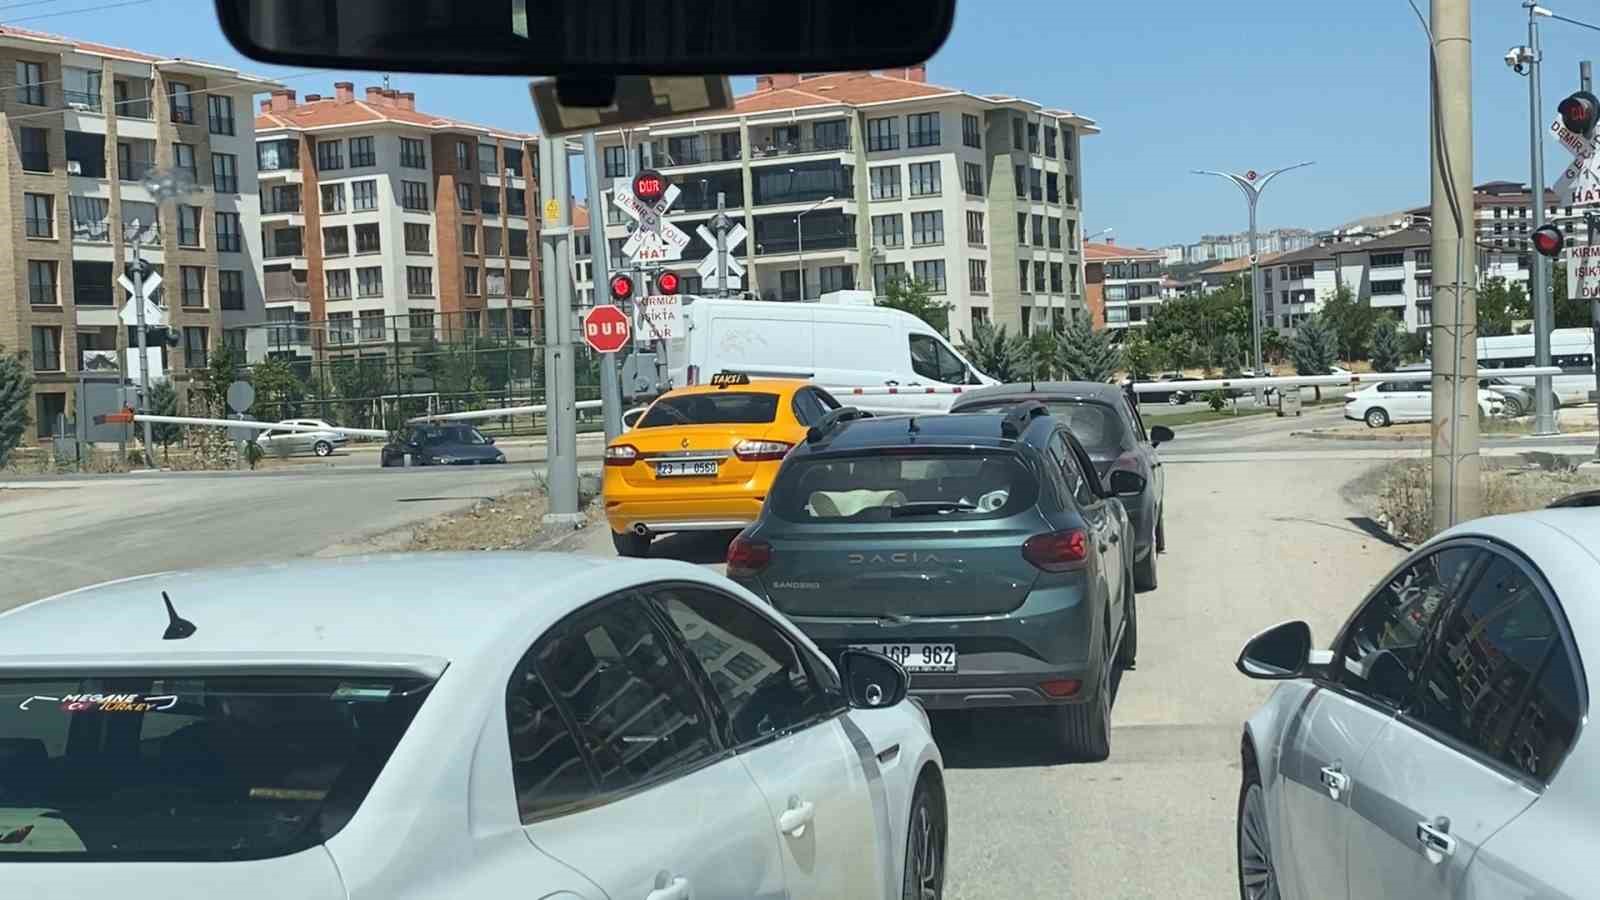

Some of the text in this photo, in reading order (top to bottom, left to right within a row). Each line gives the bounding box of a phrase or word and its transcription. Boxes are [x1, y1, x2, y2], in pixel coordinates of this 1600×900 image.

[638, 180, 660, 193] DUR
[639, 248, 668, 260] HAT
[588, 321, 626, 336] DUR
[649, 328, 672, 338] DUR
[681, 463, 686, 473] T
[847, 551, 940, 564] DACIA
[923, 645, 954, 665] 962
[62, 693, 139, 703] MEGANE
[99, 702, 156, 711] TURKEY
